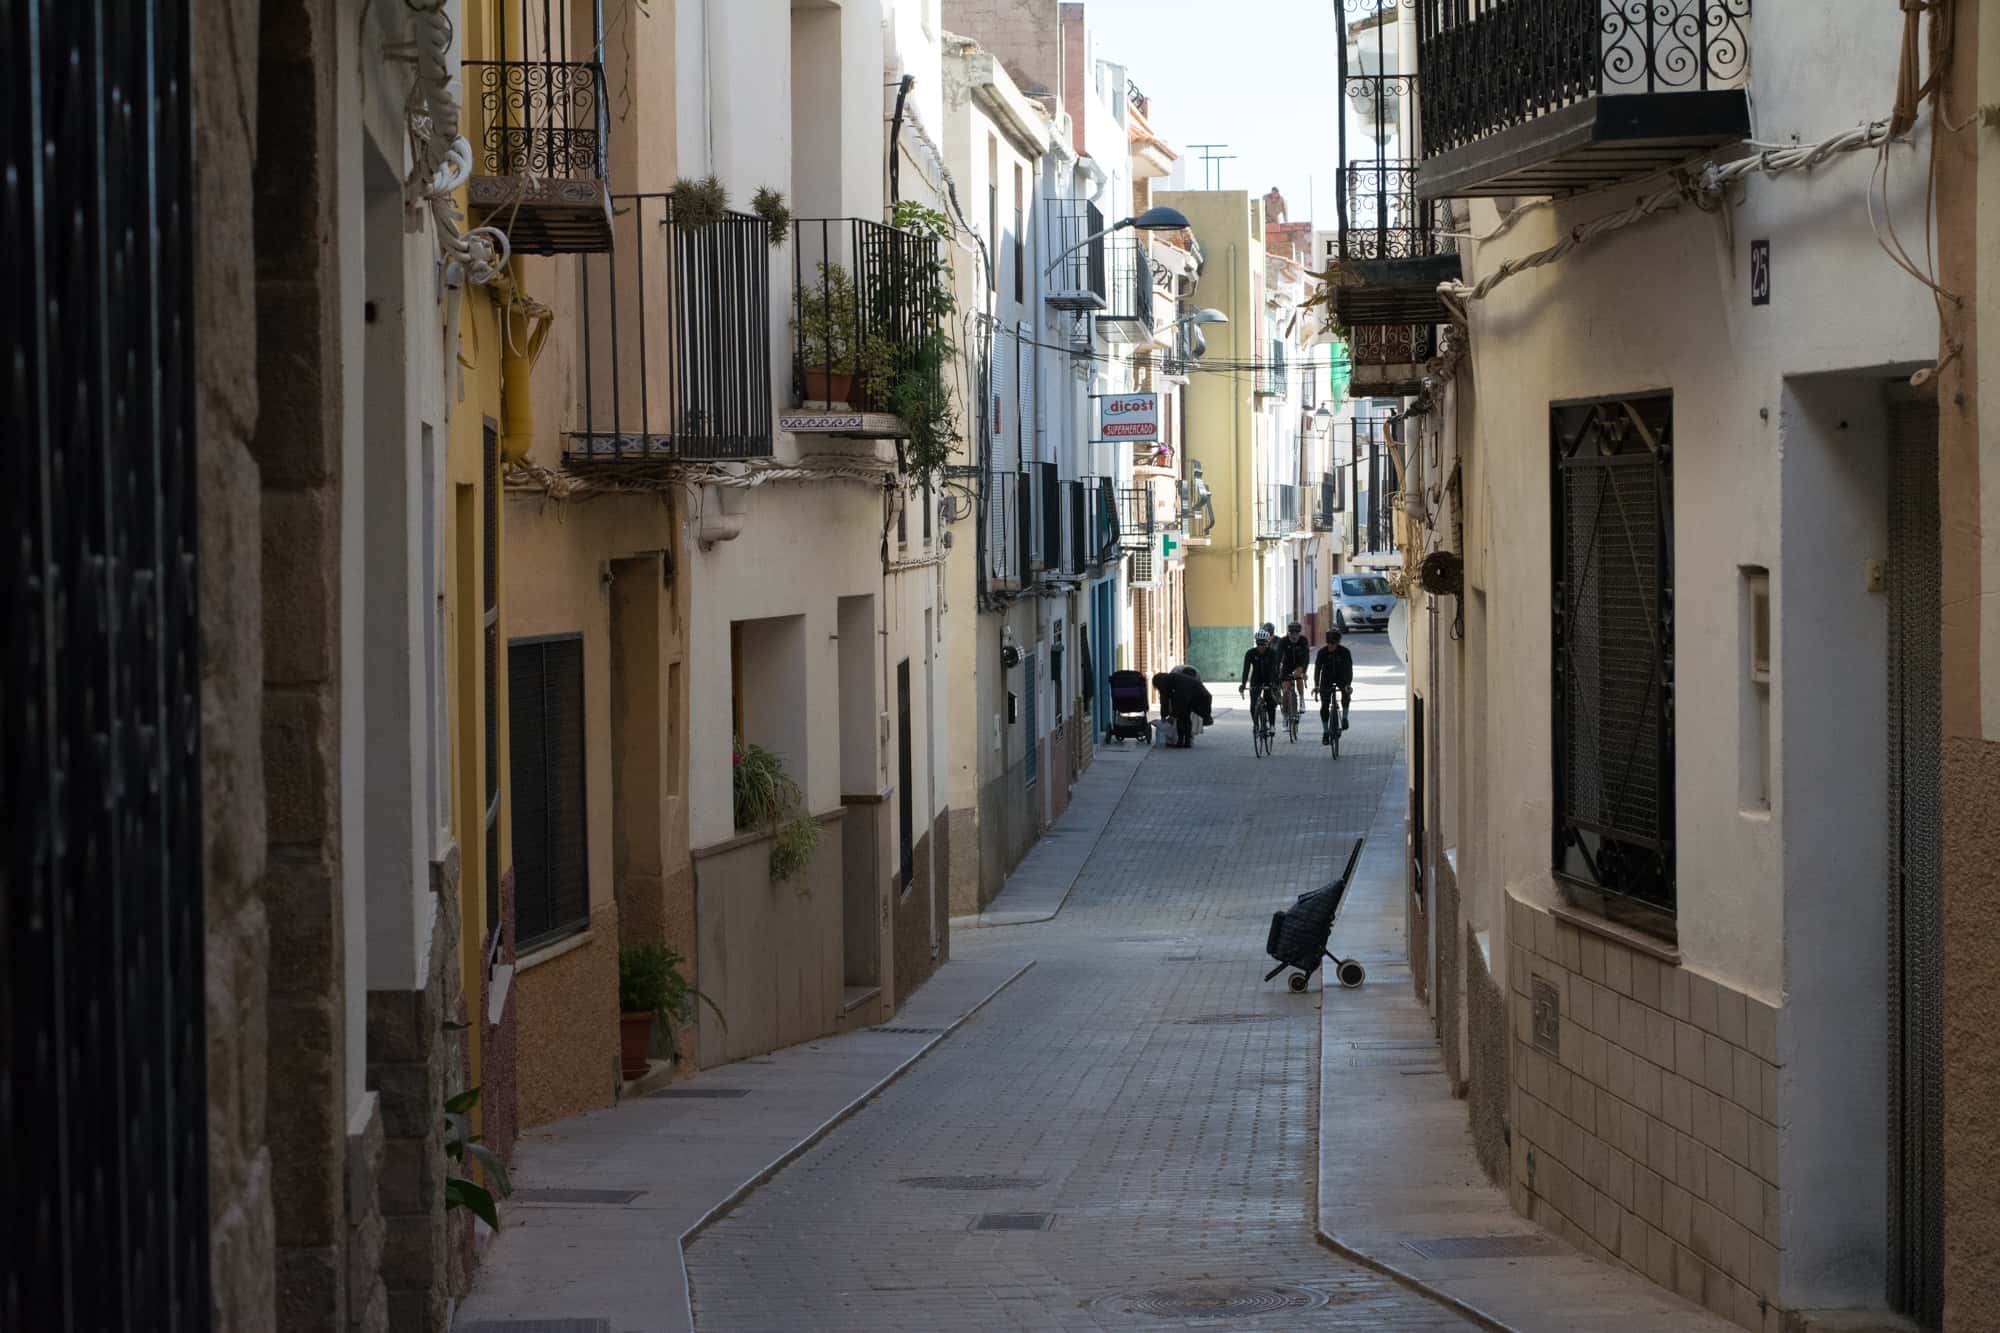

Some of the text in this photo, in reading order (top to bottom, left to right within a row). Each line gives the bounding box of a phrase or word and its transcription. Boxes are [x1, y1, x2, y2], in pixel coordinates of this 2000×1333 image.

[1752, 247, 1768, 297] 25
[1110, 400, 1154, 412] dicost
[1107, 424, 1153, 435] SUPERMERCADO
